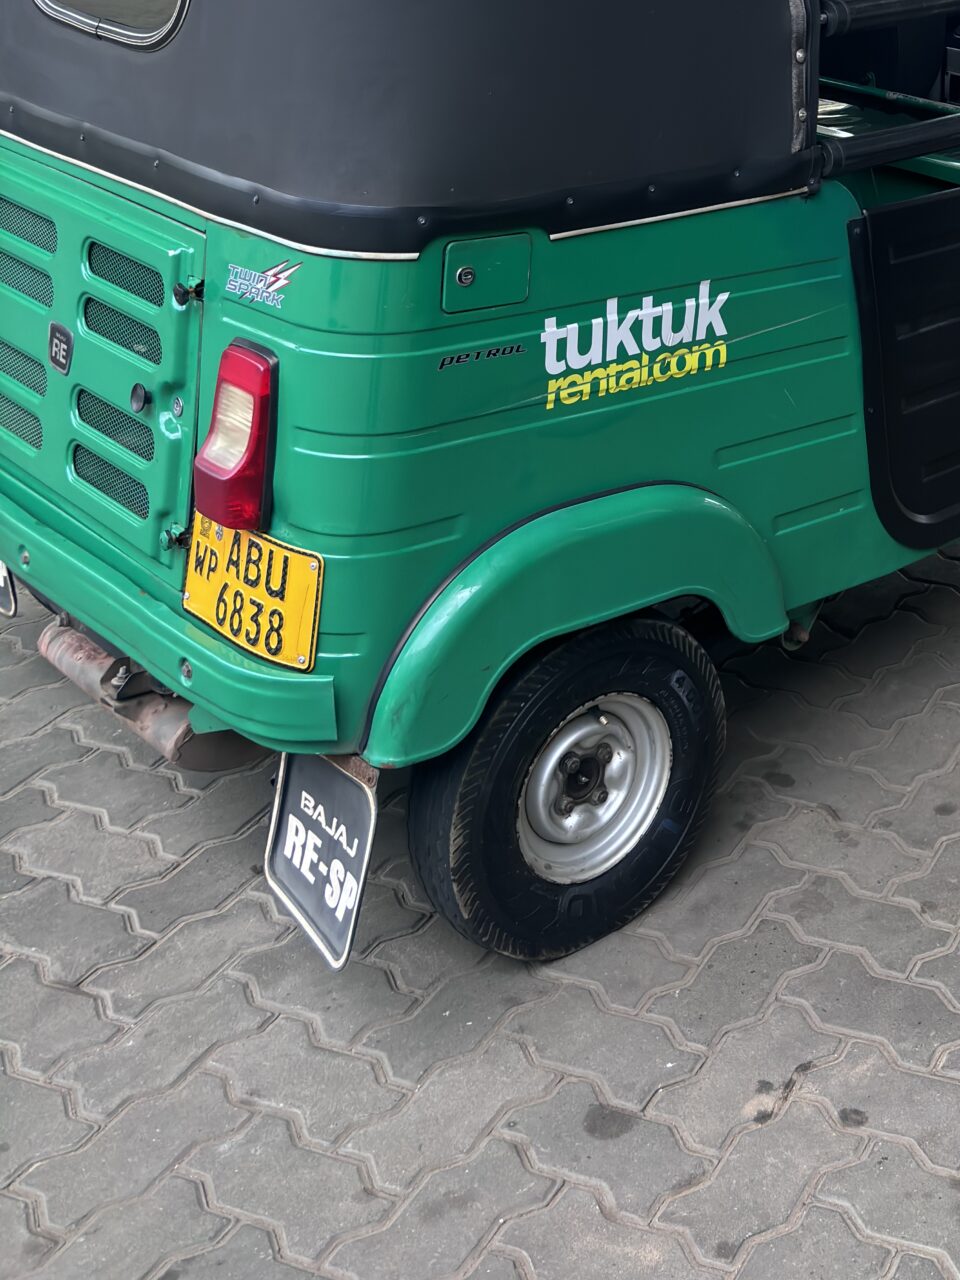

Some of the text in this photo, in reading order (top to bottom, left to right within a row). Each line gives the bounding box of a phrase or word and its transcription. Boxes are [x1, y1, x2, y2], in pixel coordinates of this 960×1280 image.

[226, 278, 285, 310] SPARK
[229, 264, 270, 288] TWIN
[52, 337, 68, 365] RE
[541, 280, 730, 375] tuktuk
[546, 340, 727, 410] rental.com
[194, 530, 291, 602] WP ABU
[215, 582, 284, 657] 6838
[300, 789, 359, 858] BAJAJ
[283, 812, 359, 923] RE-SP
